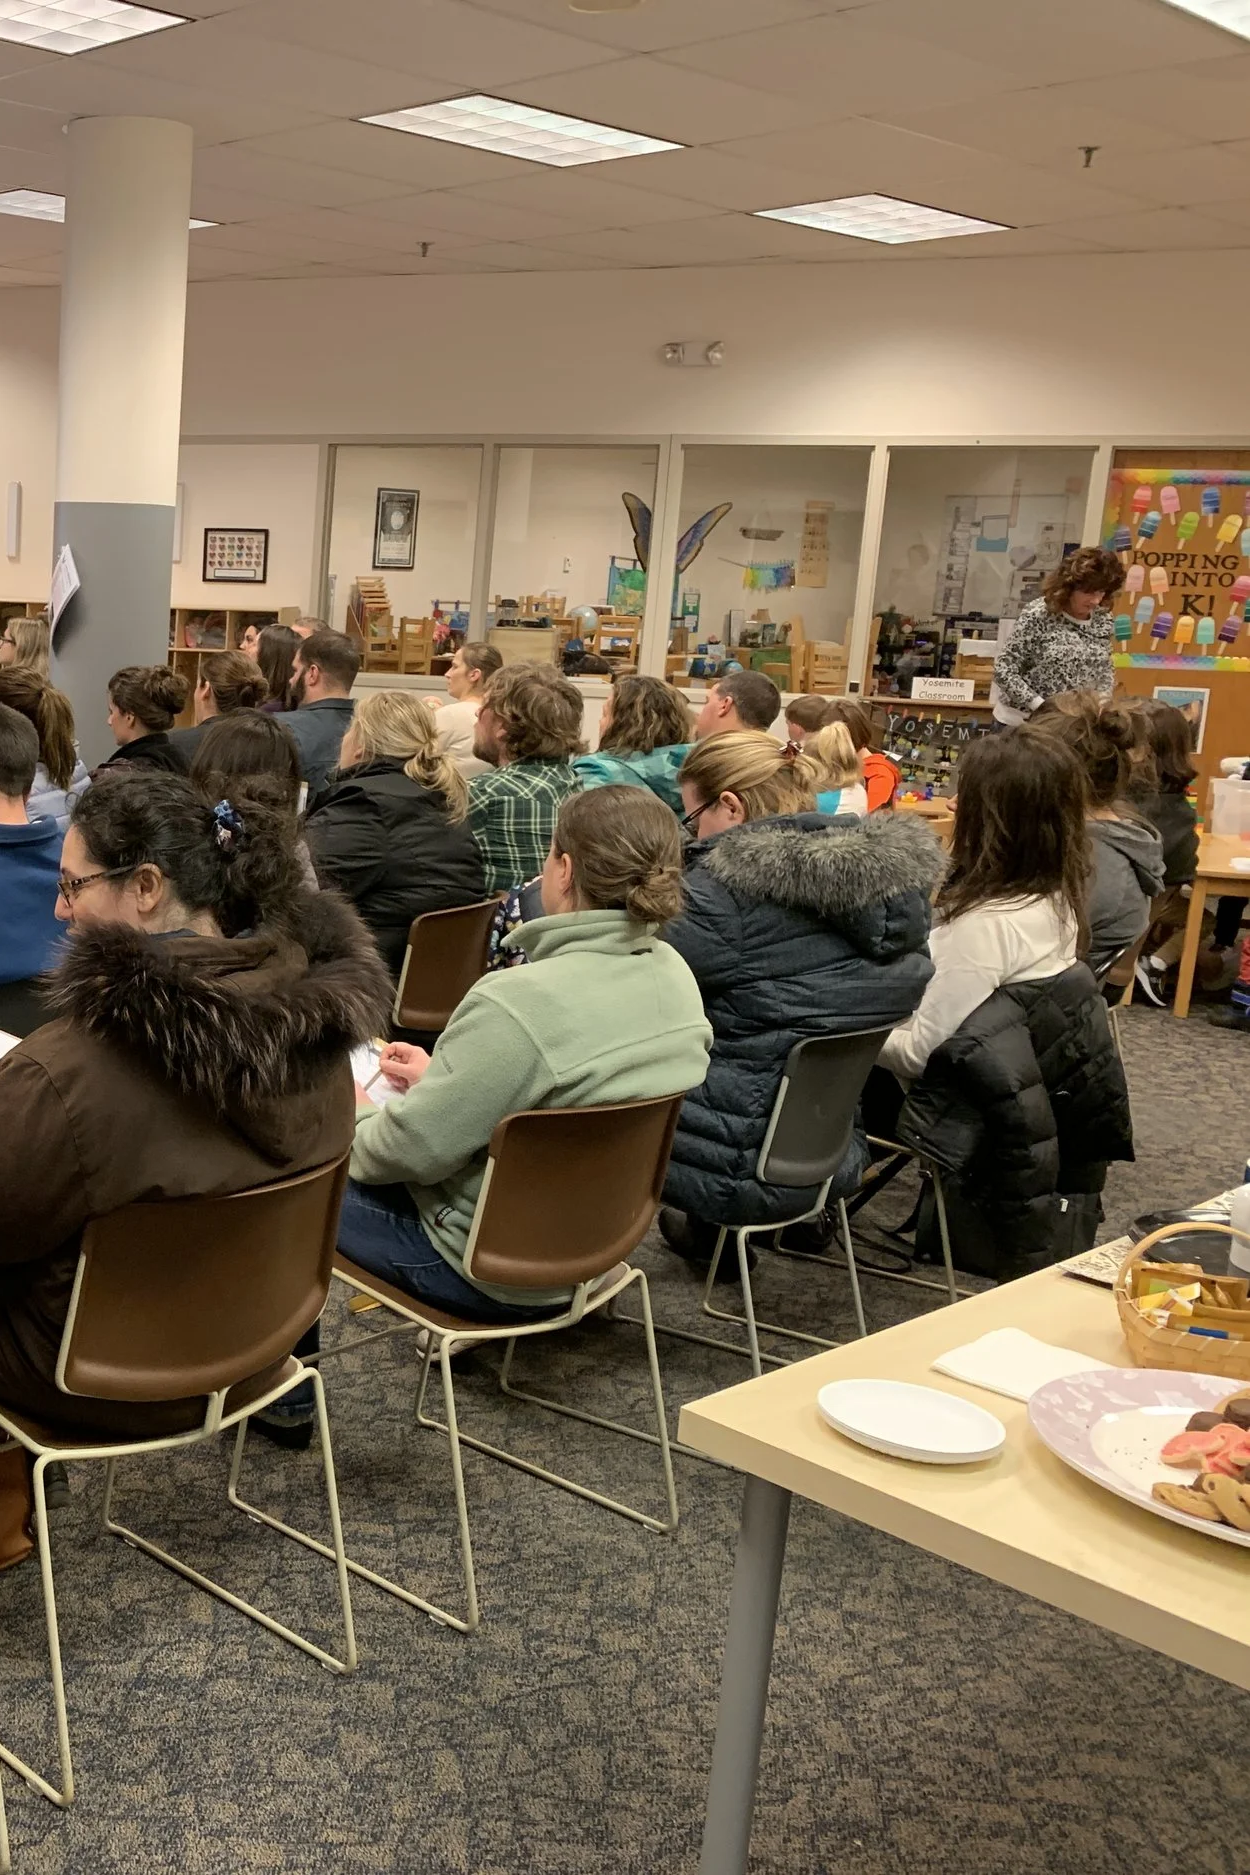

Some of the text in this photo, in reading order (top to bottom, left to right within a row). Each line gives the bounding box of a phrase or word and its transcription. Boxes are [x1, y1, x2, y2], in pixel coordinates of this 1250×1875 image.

[1132, 551, 1239, 570] POPPING
[1170, 571, 1236, 587] INTO
[1179, 594, 1215, 616] K!
[922, 679, 965, 688] Yosemite
[919, 691, 966, 701] Classroom
